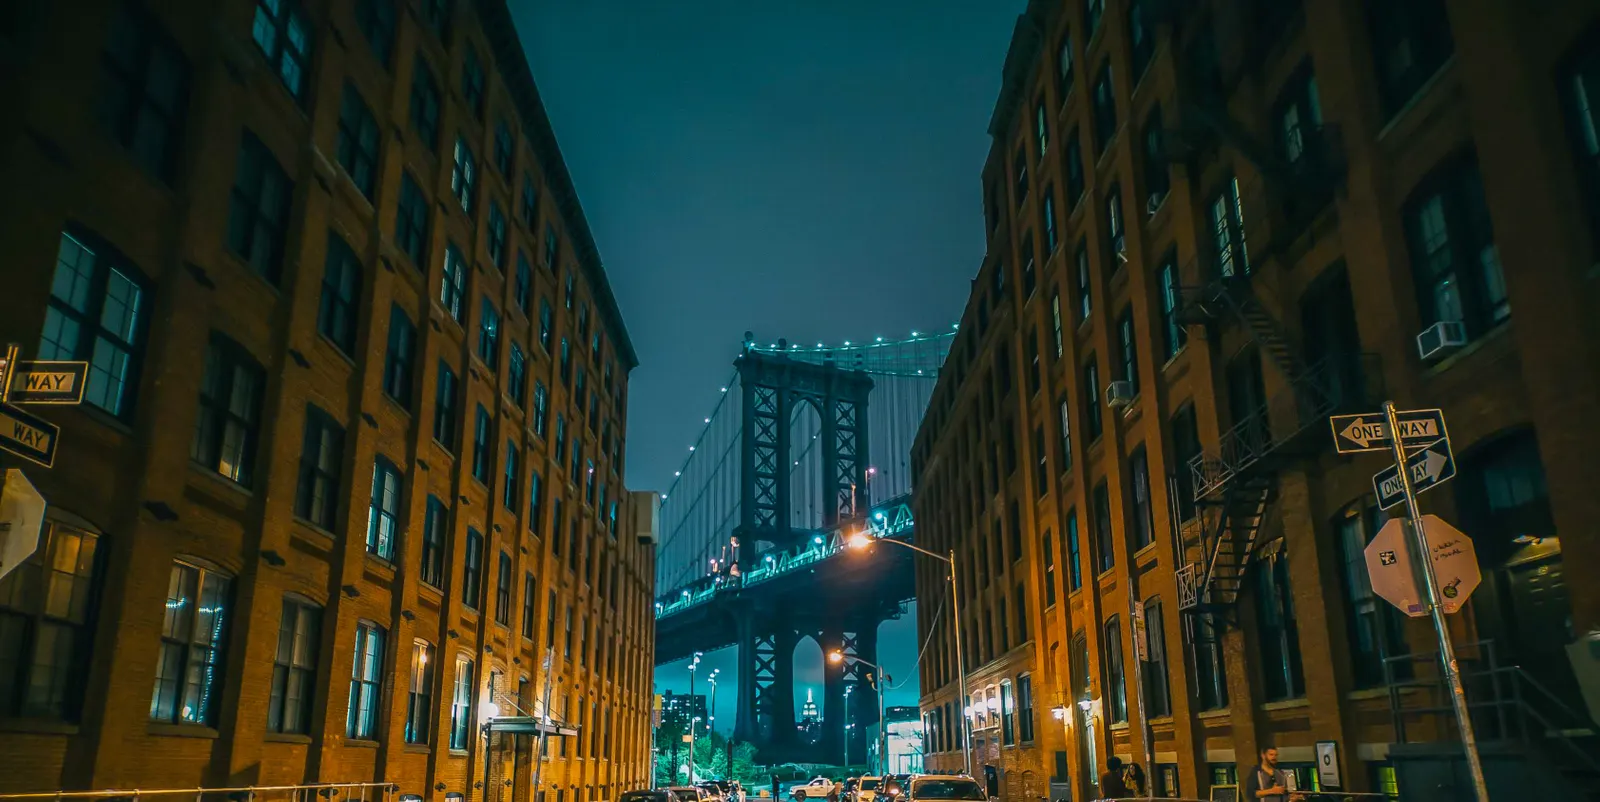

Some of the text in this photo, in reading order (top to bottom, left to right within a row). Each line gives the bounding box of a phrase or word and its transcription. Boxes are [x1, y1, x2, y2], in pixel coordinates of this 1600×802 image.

[25, 374, 66, 390] WAY
[14, 422, 44, 447] WAY
[1351, 421, 1429, 440] ONE WAY
